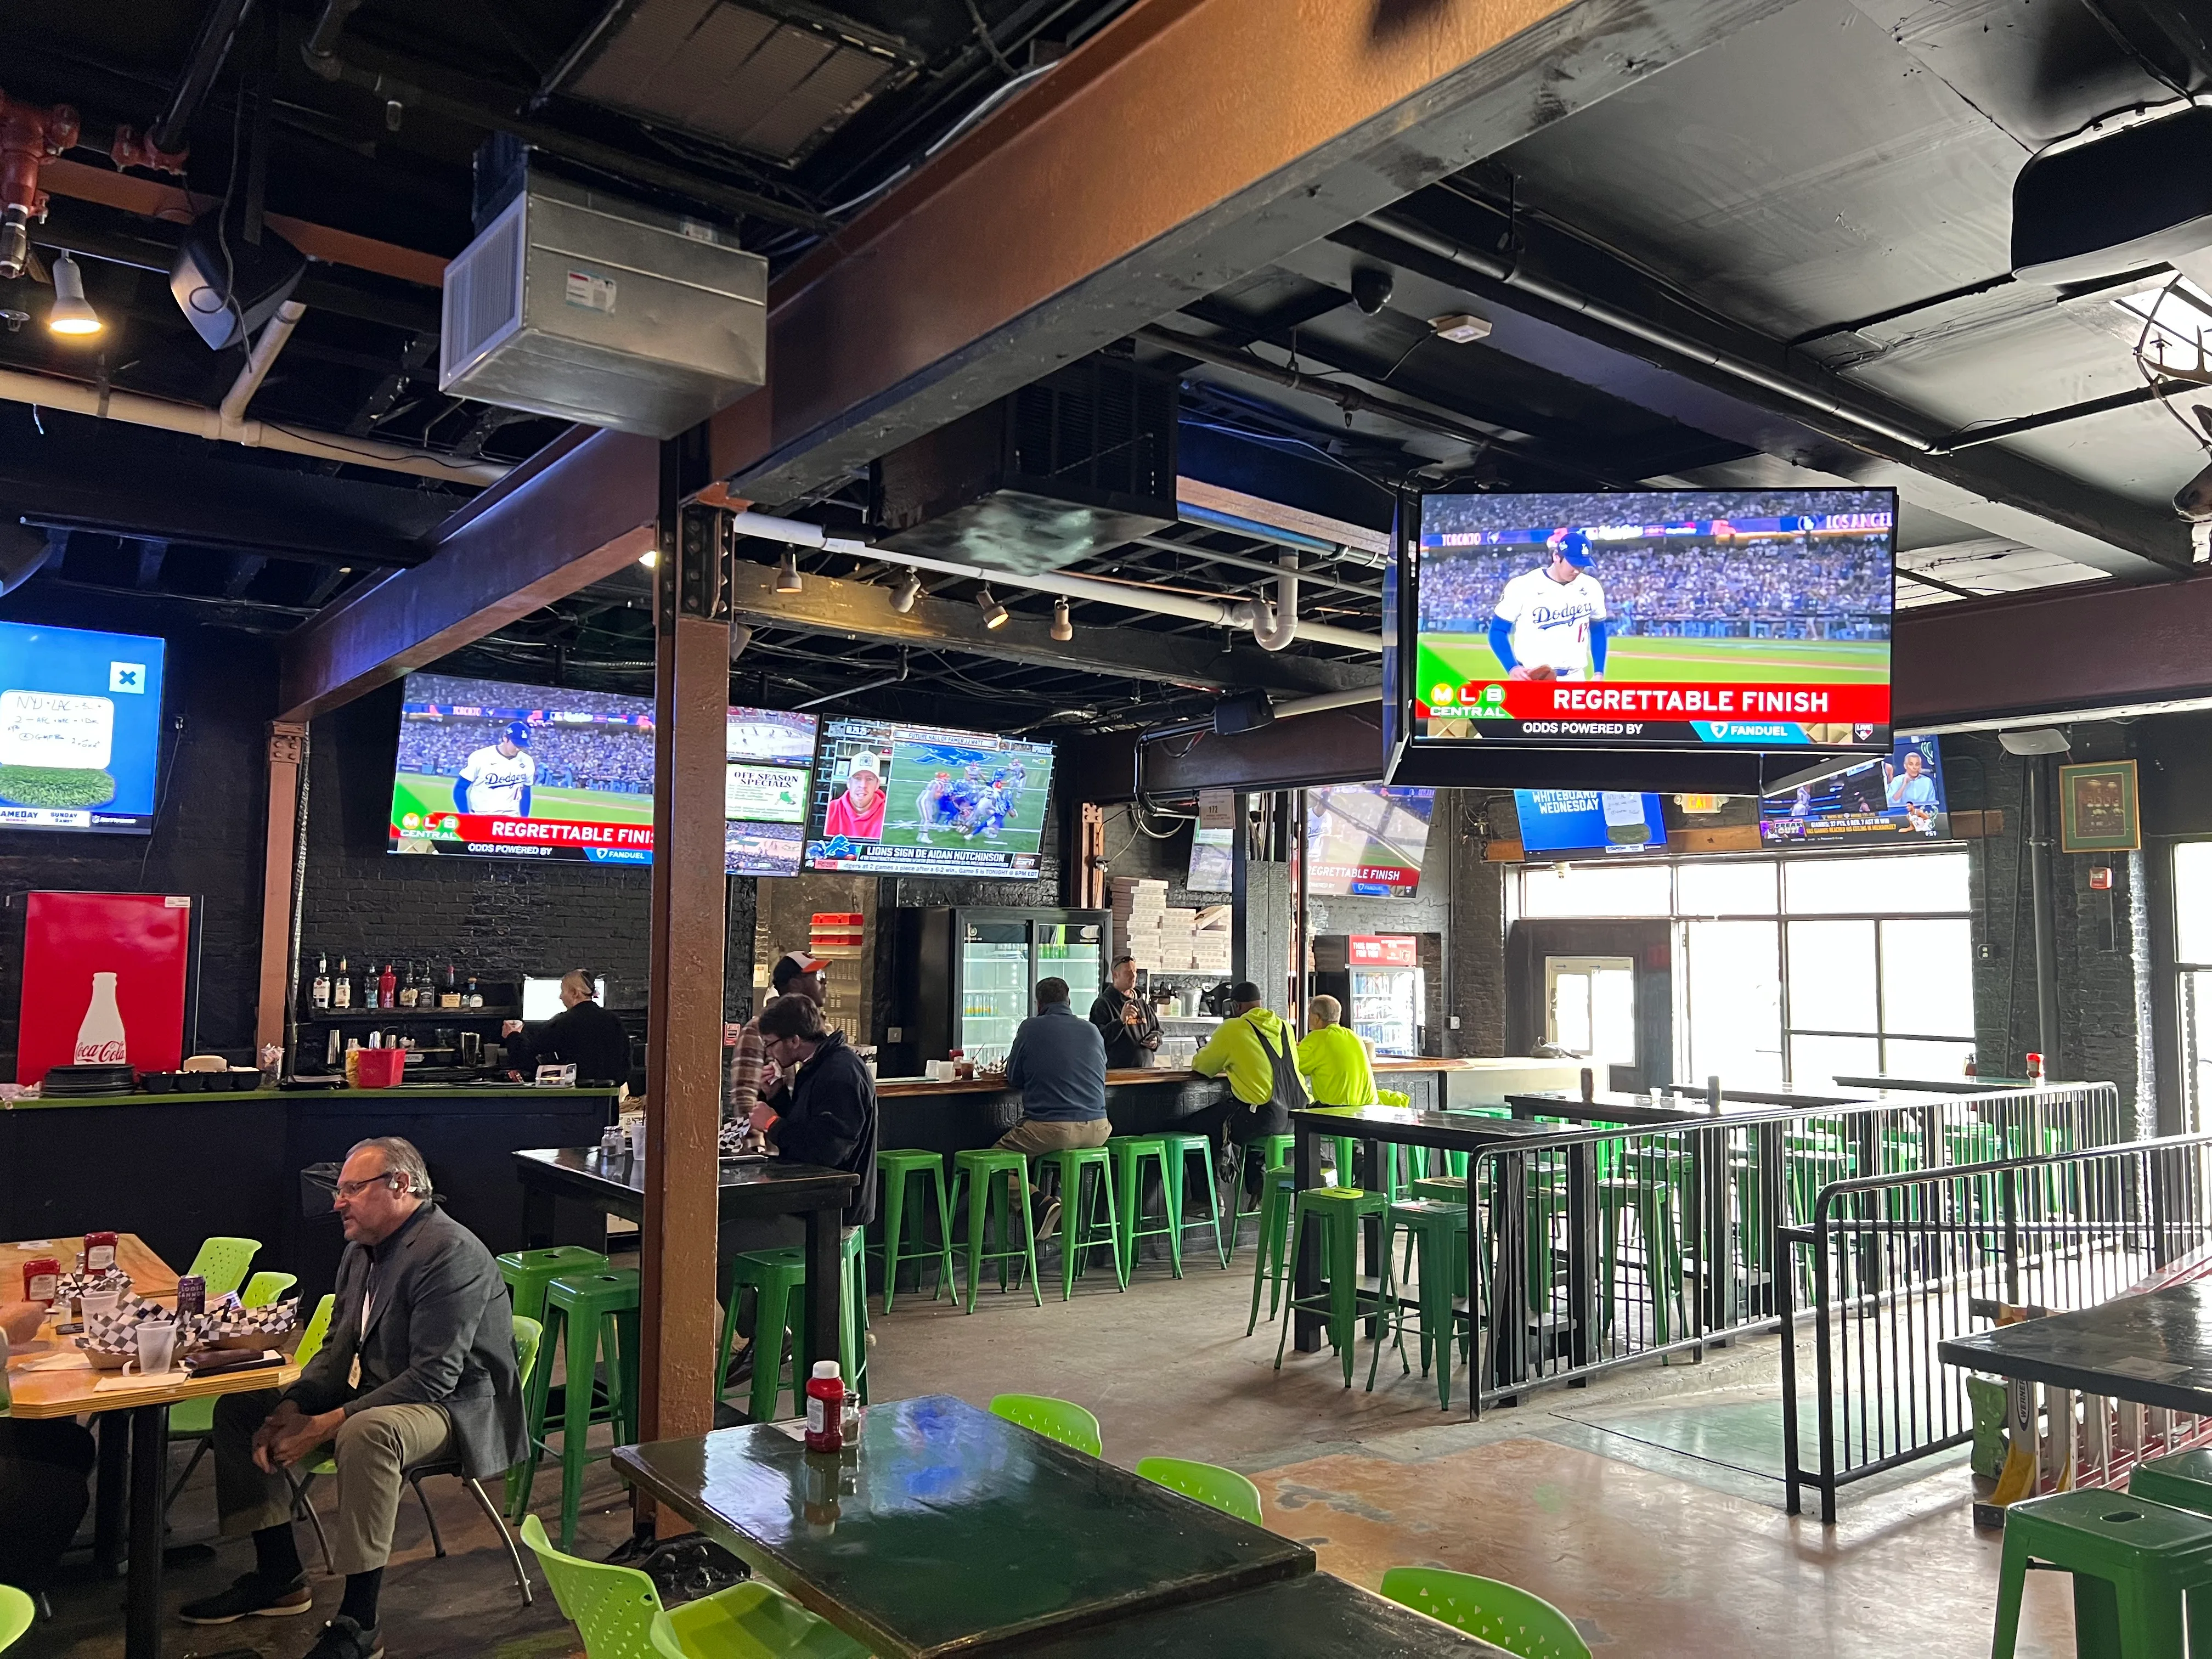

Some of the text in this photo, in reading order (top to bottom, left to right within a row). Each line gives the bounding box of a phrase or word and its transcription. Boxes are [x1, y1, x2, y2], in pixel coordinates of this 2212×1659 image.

[1442, 532, 1481, 546] TORONTO
[1554, 689, 1827, 712] REGRETTABLE FINISH
[1430, 706, 1505, 717] CENTRAL
[1522, 722, 1643, 735] ODDS POWERED BY
[1730, 725, 1788, 736] FANDUEL
[740, 778, 792, 788] SPECIALS
[758, 773, 798, 782] SEASON
[1209, 805, 1218, 814] 172
[1539, 798, 1599, 814] WEDNESDAY
[400, 830, 458, 840] CENTRAL
[492, 821, 613, 842] REGRETTABLE
[468, 843, 552, 855] ODDS POWERED BY
[608, 850, 645, 859] FANDUEL
[867, 846, 1005, 862] LIONS SIGN DE AIDAN HUTCHINSON
[1016, 857, 1035, 866] ESPN
[1370, 870, 1400, 881] FINISH
[76, 1041, 125, 1063] Coca-Cola
